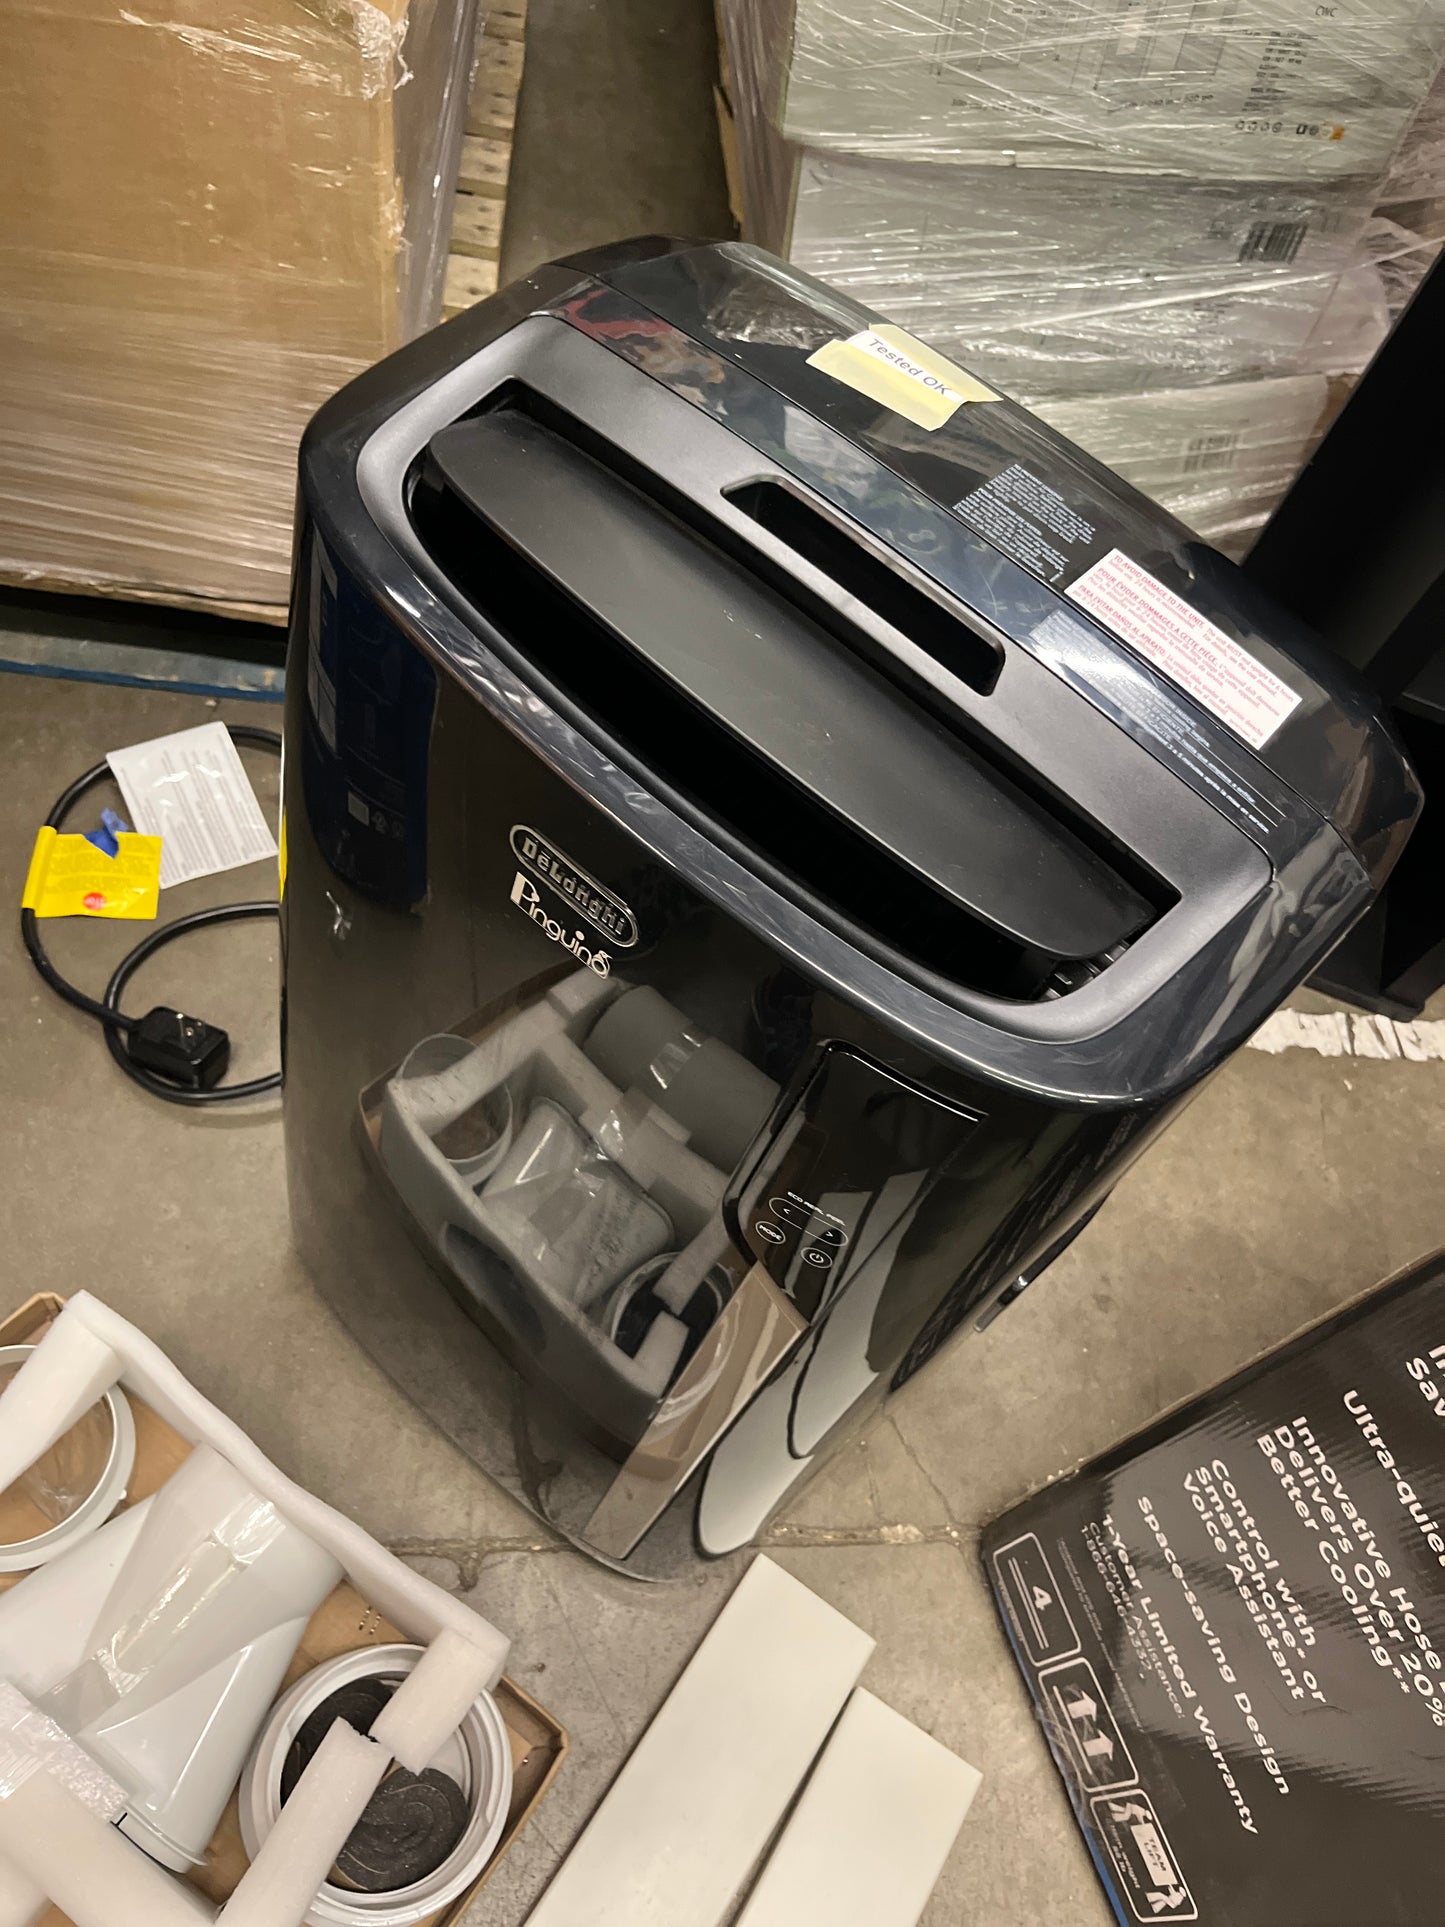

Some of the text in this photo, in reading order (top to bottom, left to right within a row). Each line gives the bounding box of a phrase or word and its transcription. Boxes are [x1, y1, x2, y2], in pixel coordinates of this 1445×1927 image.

[870, 338, 952, 395] Tested OK
[1078, 584, 1095, 598] PARA
[1092, 596, 1113, 612] EVITAR
[1111, 610, 1134, 628] DAÑOS
[1131, 626, 1141, 634] AL
[1096, 567, 1117, 583] POUR
[1137, 598, 1175, 629] DOMMAGES
[1178, 631, 1200, 649] CETTE
[1113, 555, 1123, 563] TO
[1122, 561, 1142, 578] AVOID
[1140, 576, 1168, 598] DAMAGE
[1166, 596, 1177, 605] TO
[1175, 603, 1188, 614] THE
[510, 871, 613, 979] Pinguino
[522, 837, 624, 935] DeLonghi
[1257, 1434, 1319, 1530] Better
[1344, 1390, 1445, 1566] Ultra-quie
[1183, 1472, 1304, 1699] Voice Assistant
[1212, 1459, 1316, 1646] Control with
[1274, 1425, 1445, 1726] Delivers Over 20%
[1292, 1416, 1441, 1669] Innovative Hose
[1032, 1586, 1052, 1610] 4
[1090, 1522, 1186, 1719] Customer Assistance:
[1137, 1496, 1289, 1794] Space-saving Design
[1102, 1514, 1258, 1833] 1-Year Limited Warranty
[1302, 1670, 1326, 1703] or
[1122, 1852, 1140, 1888] weight
[1144, 1842, 1158, 1867] LIFT
[1150, 1838, 1166, 1871] TEAM
